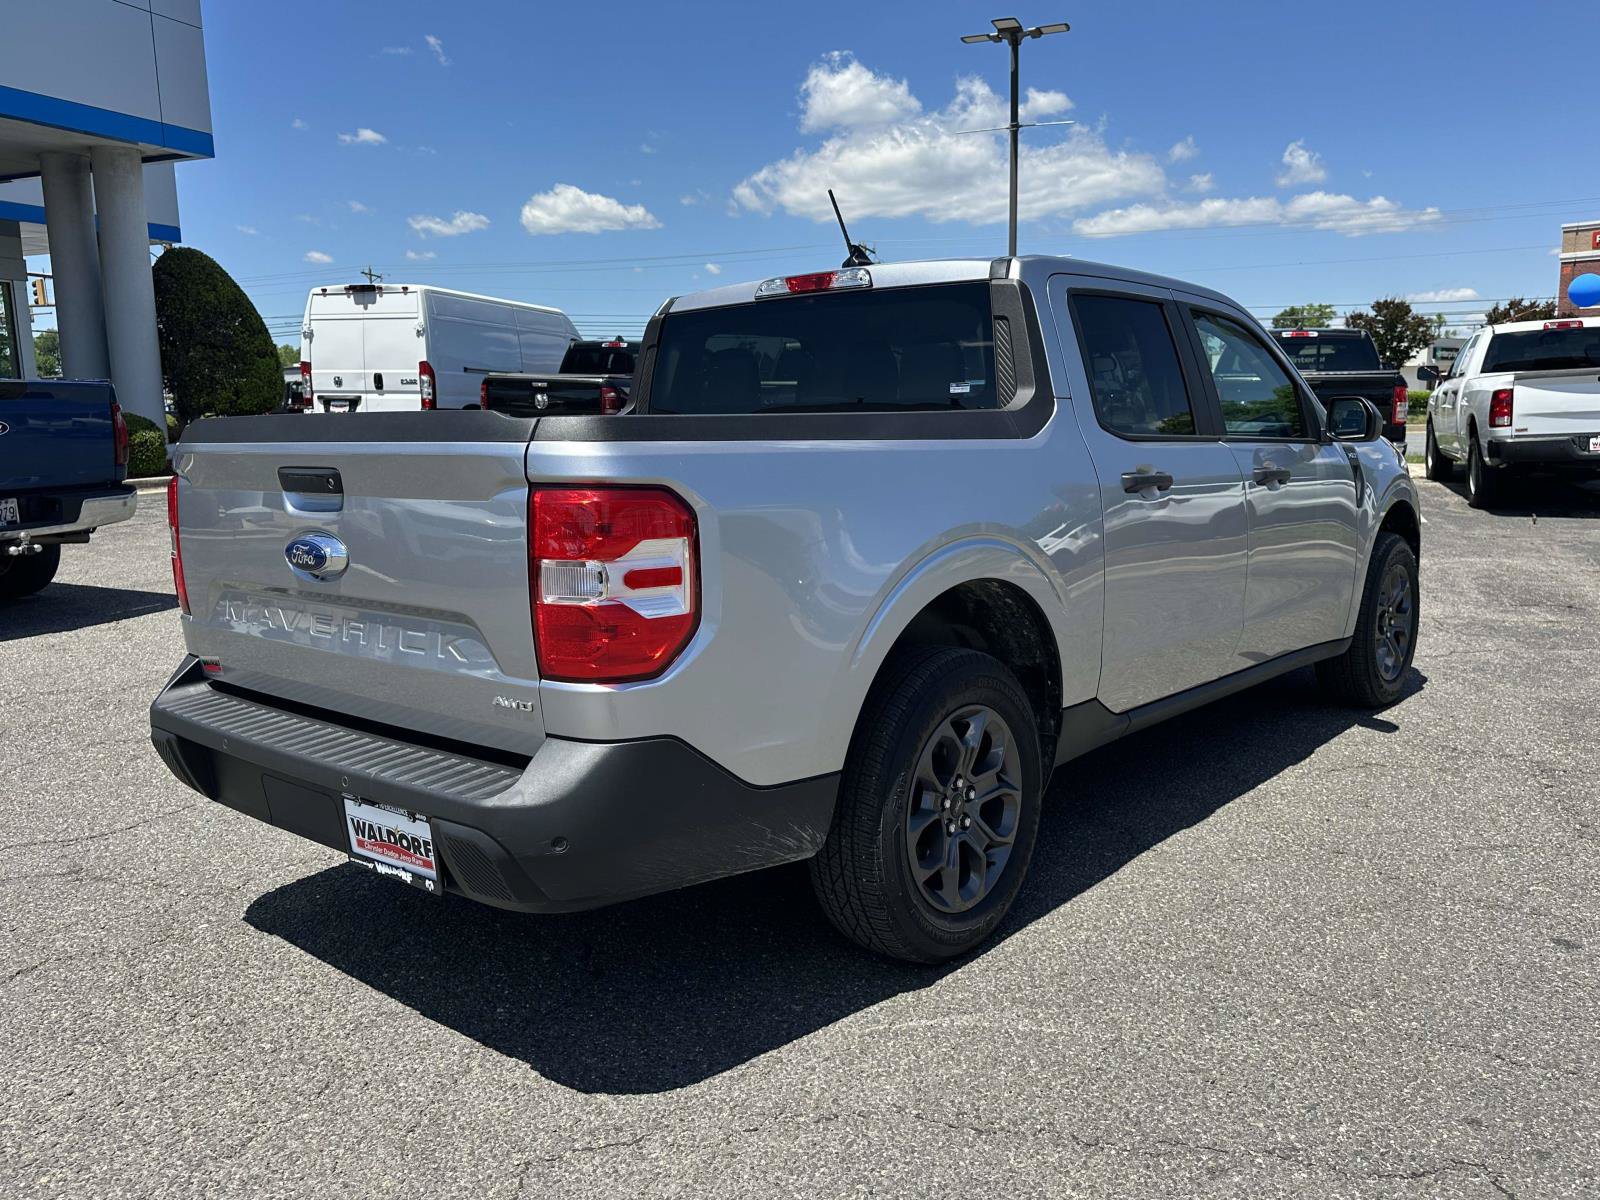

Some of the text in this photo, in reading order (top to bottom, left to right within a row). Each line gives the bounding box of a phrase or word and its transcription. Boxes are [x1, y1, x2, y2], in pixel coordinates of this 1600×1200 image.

[291, 544, 316, 566] Ford
[222, 599, 469, 663] MAVERICK
[350, 816, 432, 860] WALDORF
[364, 841, 424, 866] Chrysler Dodge Jeep Ram
